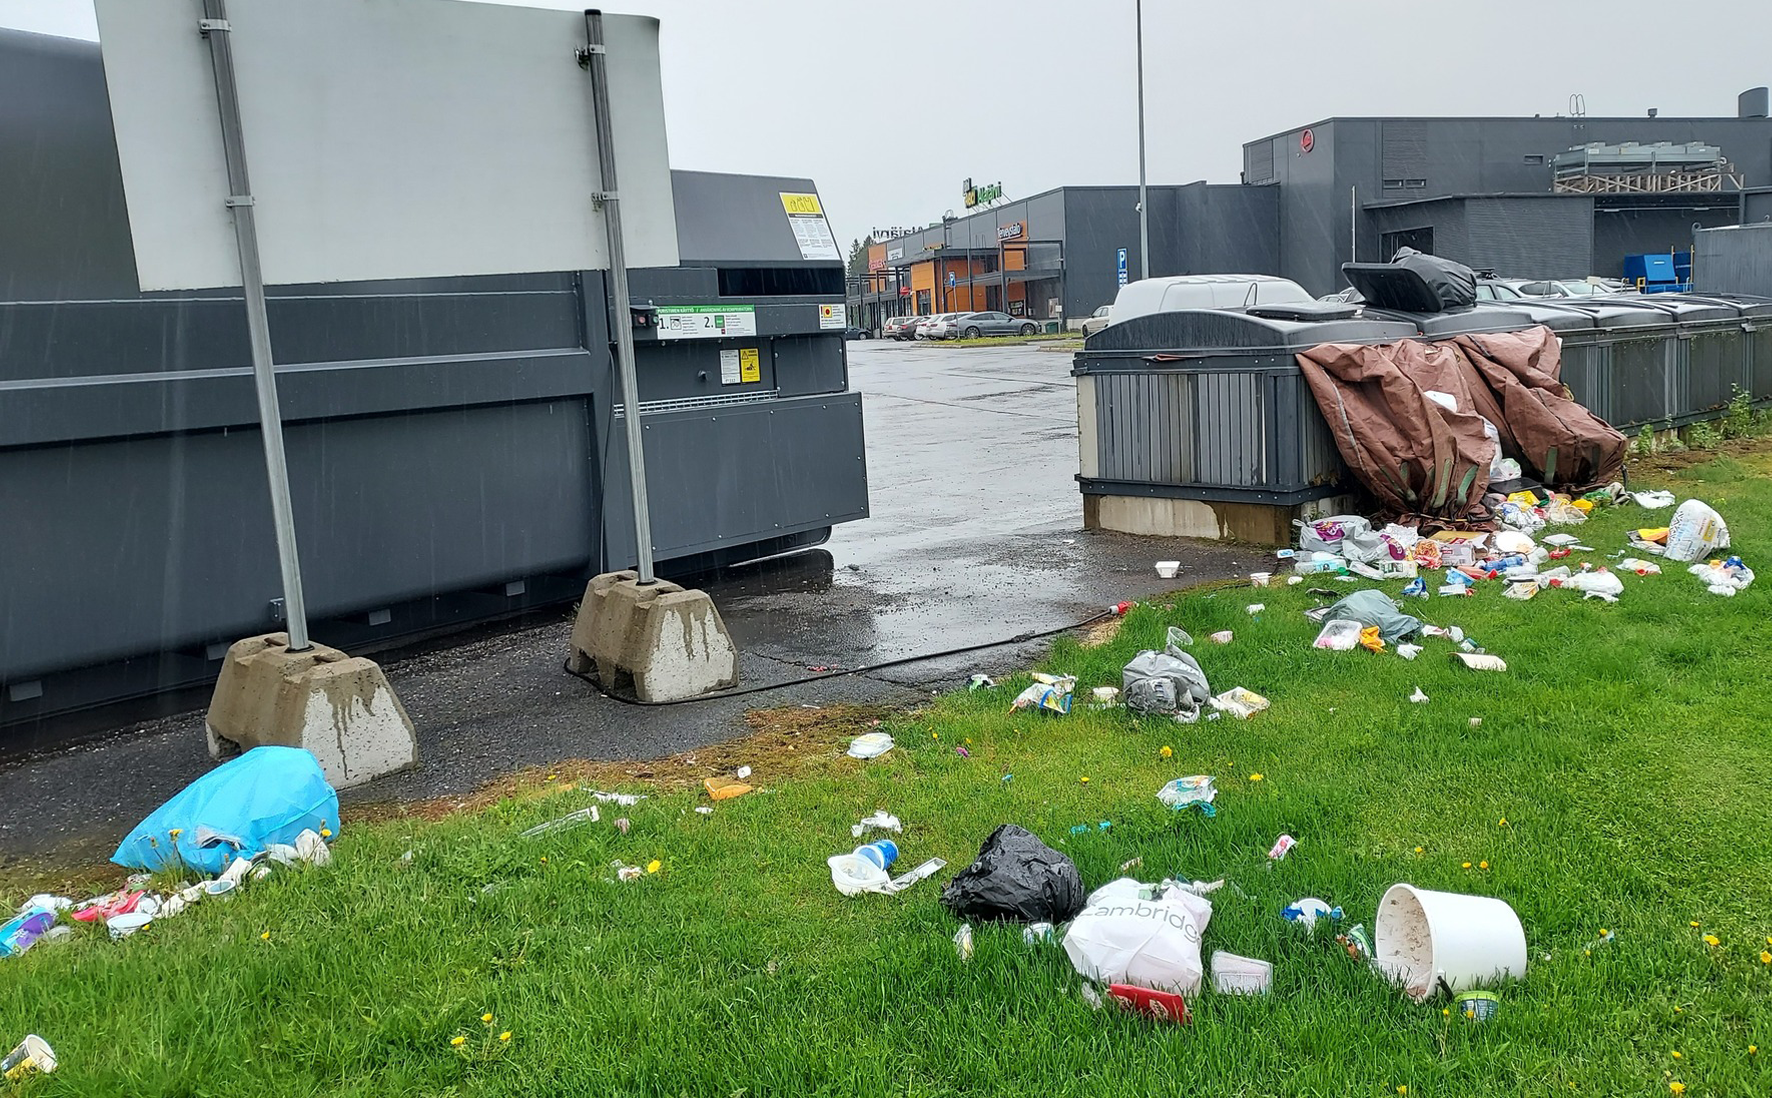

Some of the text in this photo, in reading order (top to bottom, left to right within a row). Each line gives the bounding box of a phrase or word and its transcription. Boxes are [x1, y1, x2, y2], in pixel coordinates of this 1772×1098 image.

[1119, 251, 1126, 269] P
[659, 317, 669, 330] 1.
[704, 316, 714, 328] 2.
[1079, 903, 1200, 945] ambridg
